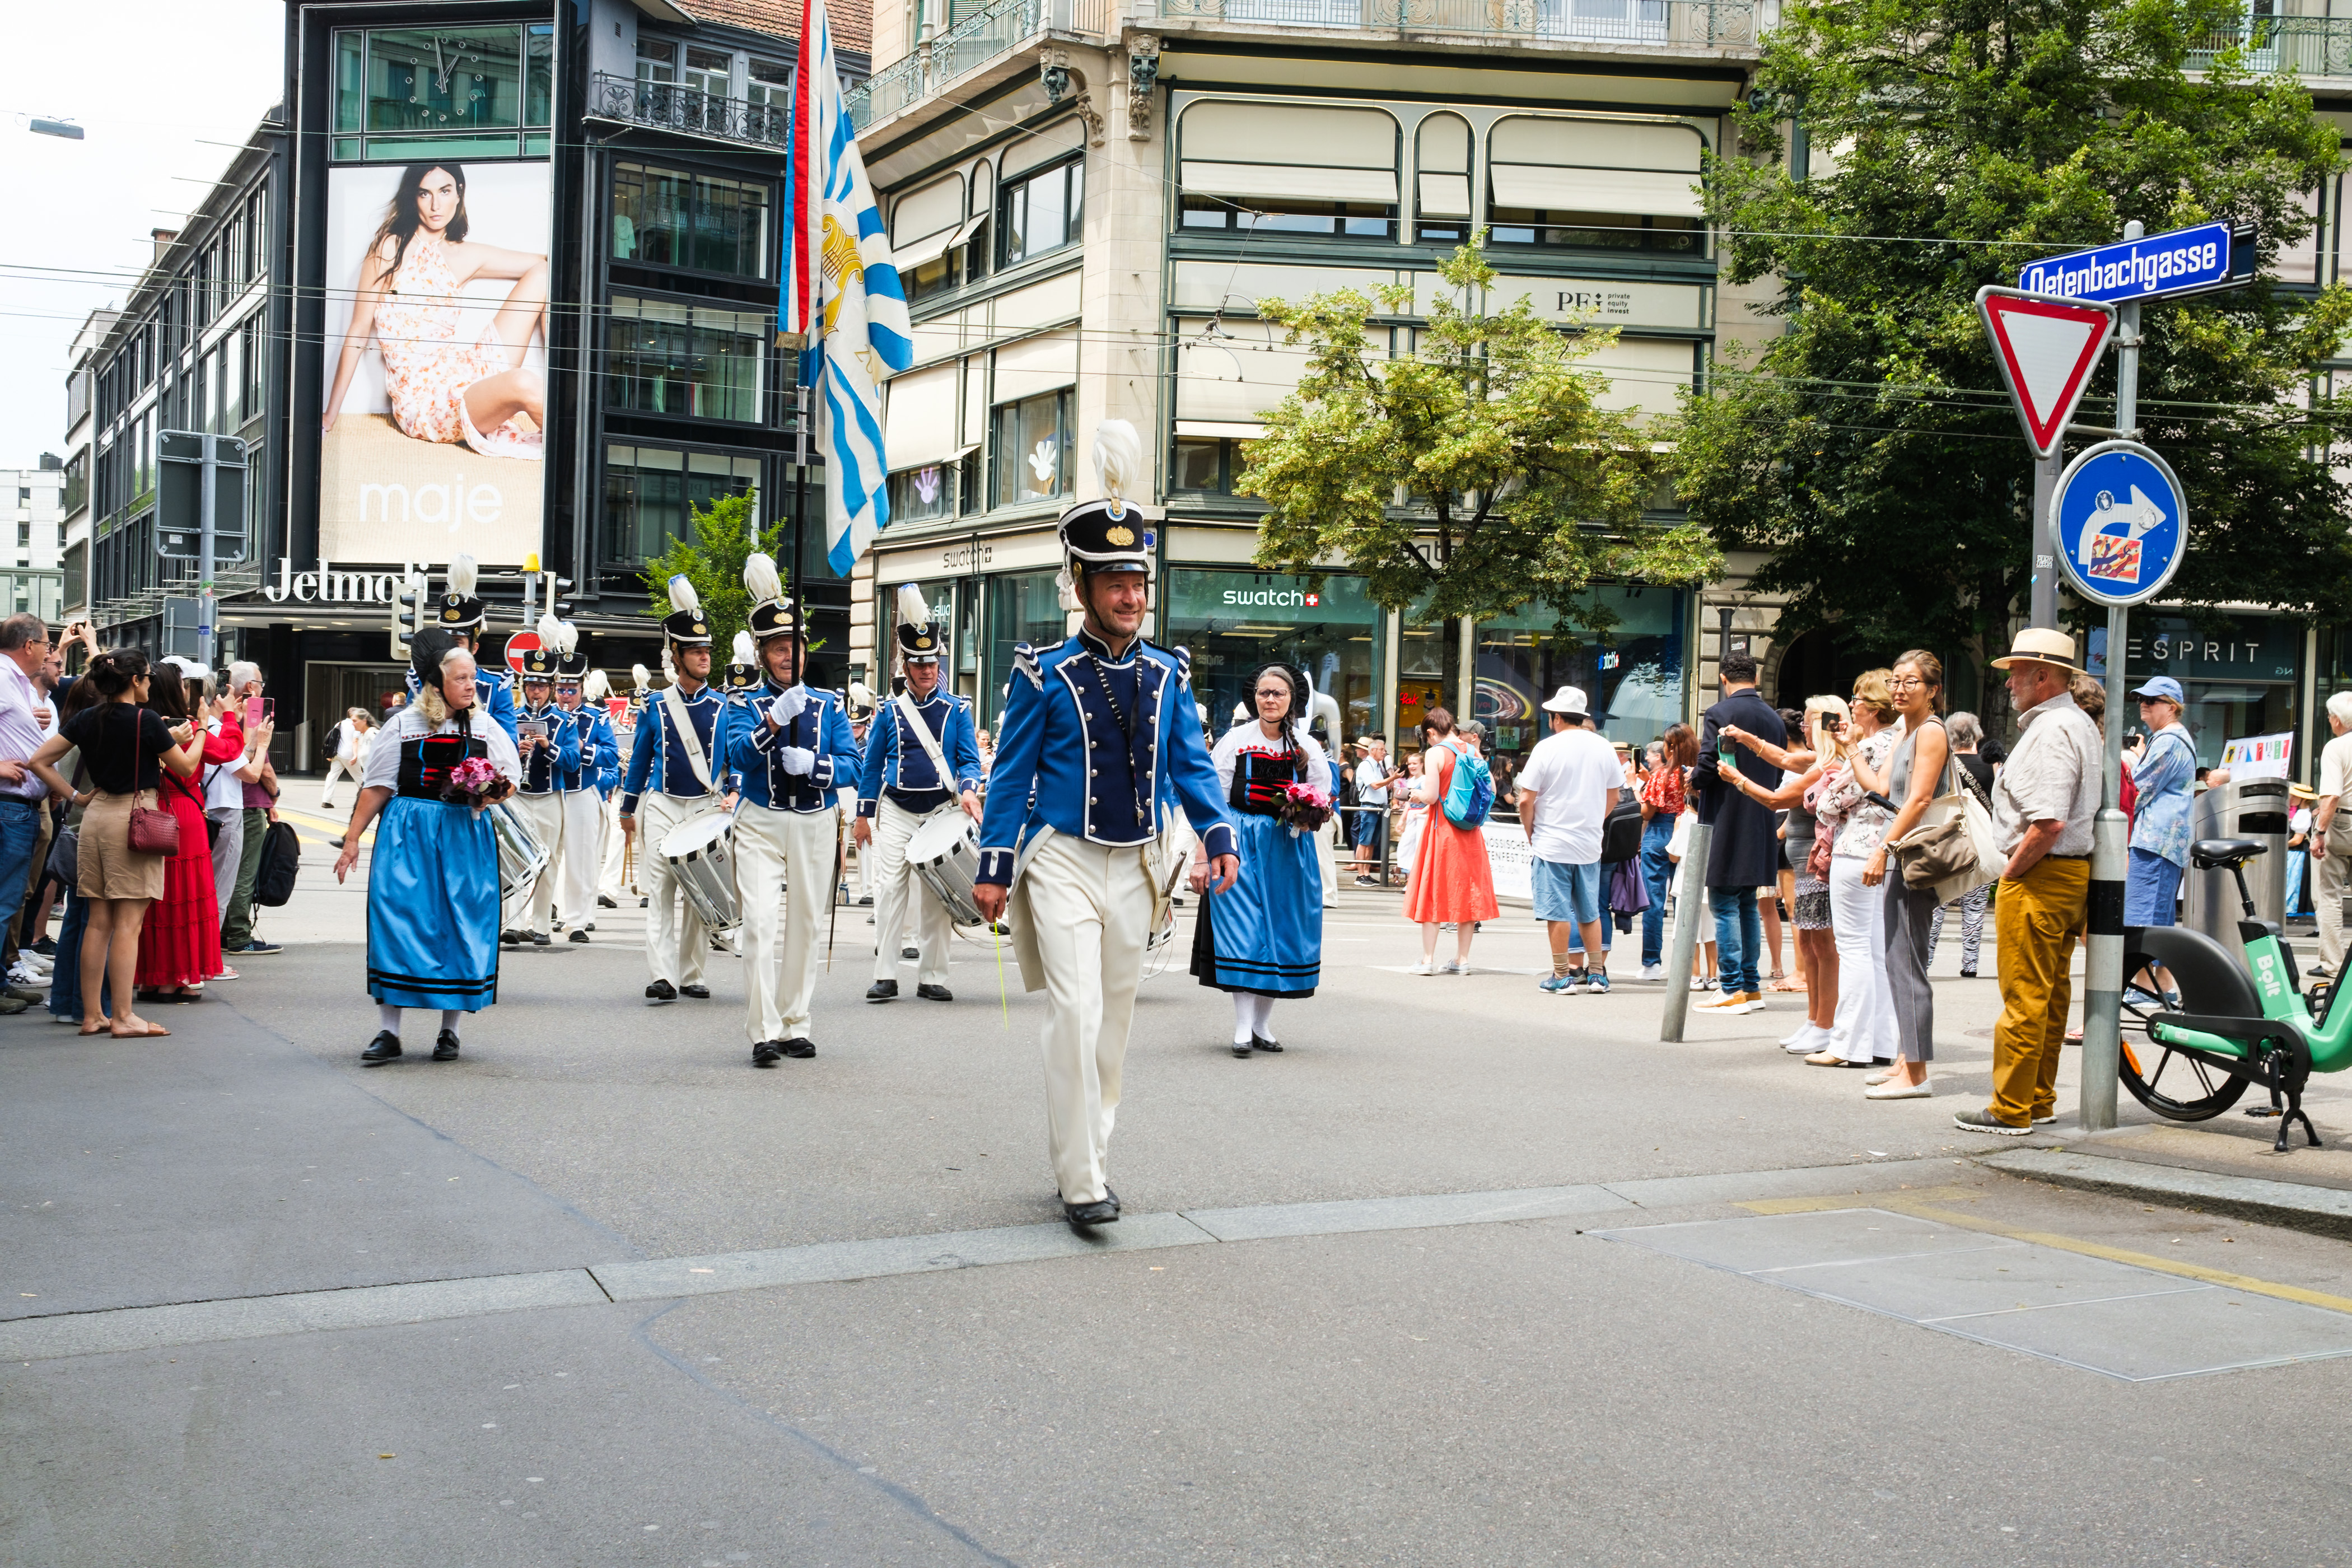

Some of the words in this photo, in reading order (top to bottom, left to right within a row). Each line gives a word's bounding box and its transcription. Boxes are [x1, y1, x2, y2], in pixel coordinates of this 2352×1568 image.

[2029, 242, 2216, 297] Oetenbachgasse
[359, 474, 502, 533] maje
[943, 544, 984, 568] swatch
[1223, 589, 1304, 606] swatch
[2127, 639, 2259, 662] ESPRIT
[2256, 954, 2281, 997] Bolt
